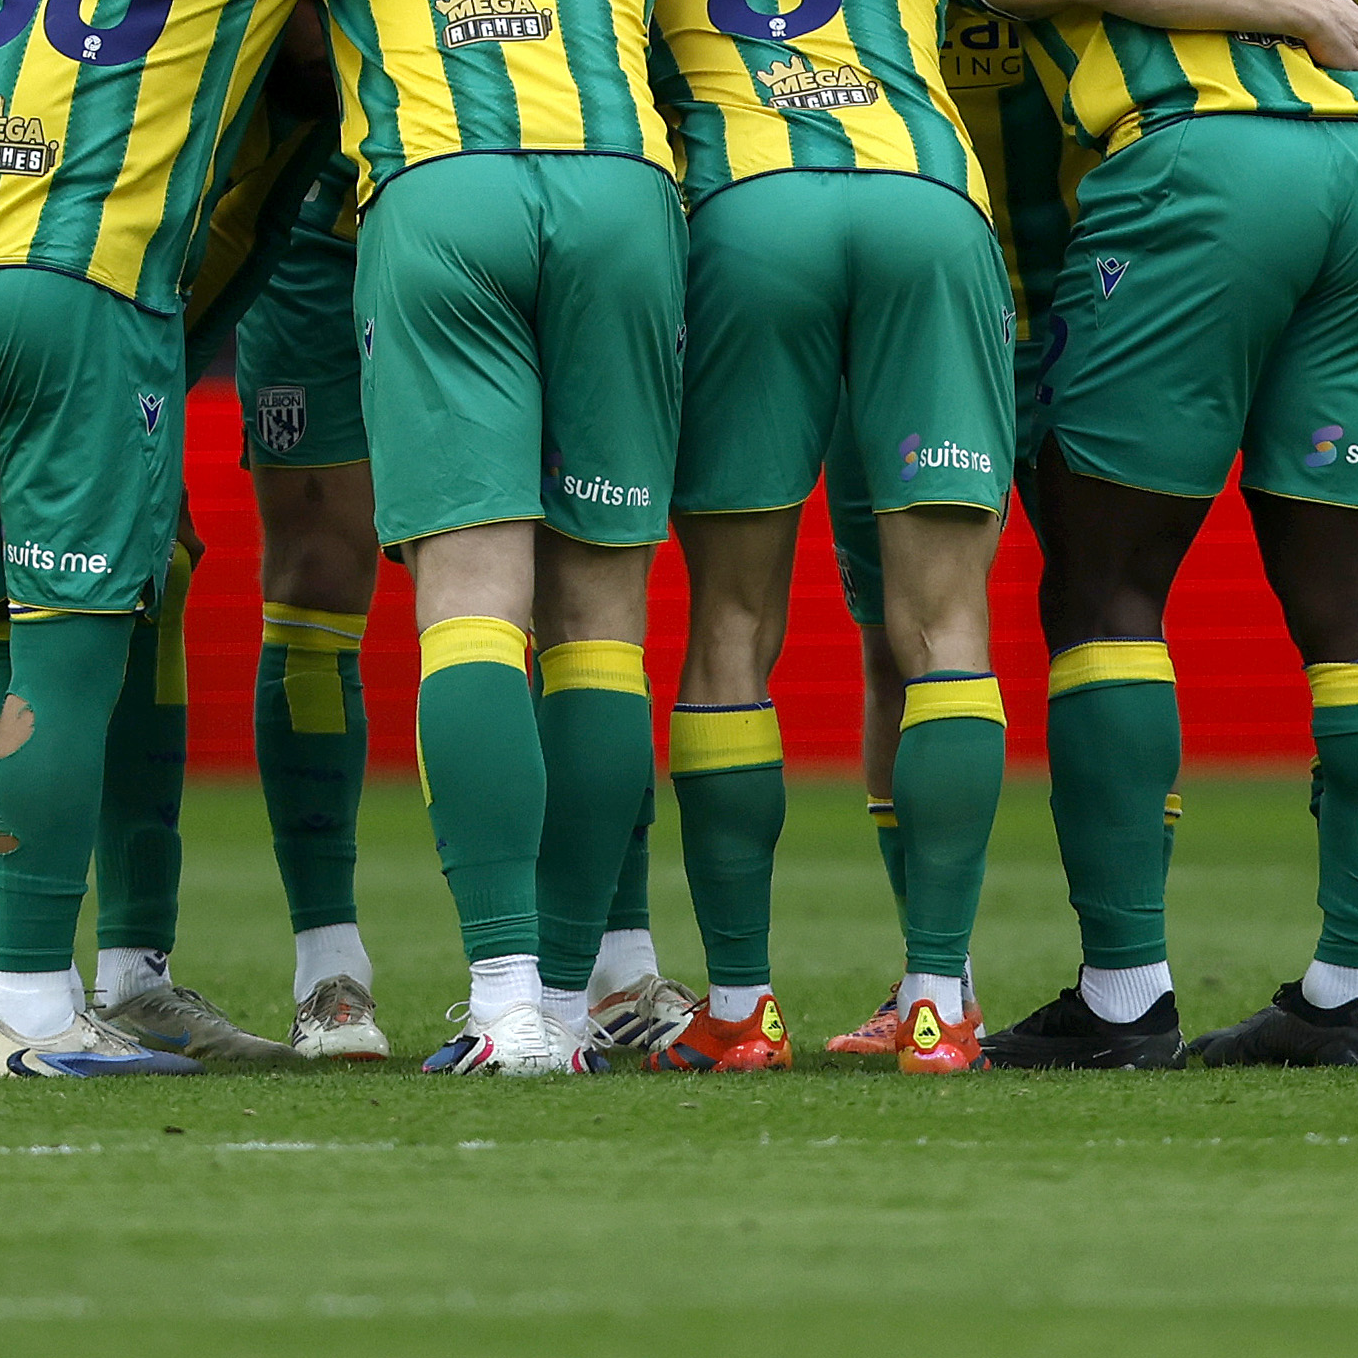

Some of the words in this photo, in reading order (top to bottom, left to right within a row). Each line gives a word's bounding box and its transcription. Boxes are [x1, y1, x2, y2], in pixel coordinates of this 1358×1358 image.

[450, 18, 539, 43] RICHES
[82, 50, 97, 60] EFL
[772, 65, 861, 95] MEGA
[259, 396, 301, 407] ALBION
[919, 440, 970, 469] suits
[564, 475, 624, 506] suits
[7, 540, 55, 570] suits
